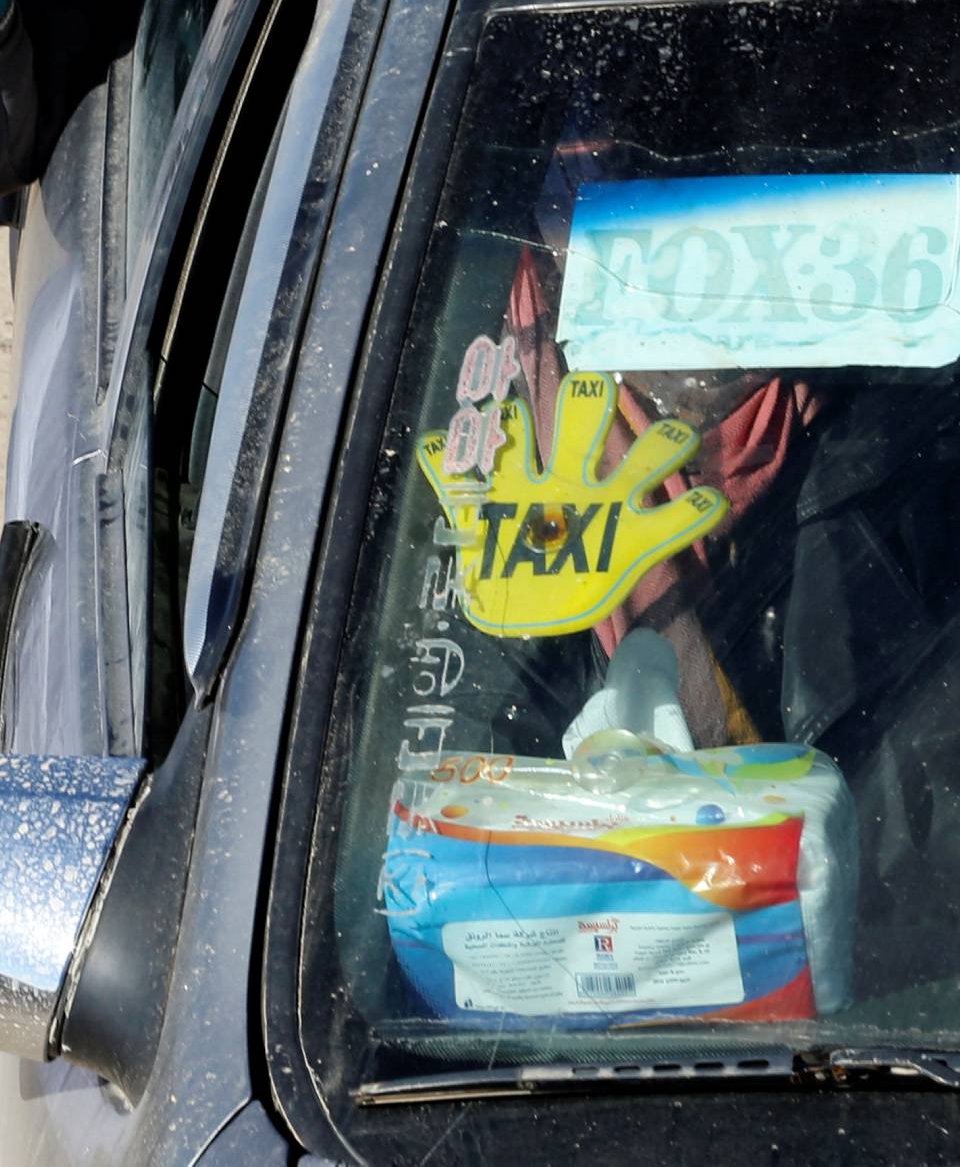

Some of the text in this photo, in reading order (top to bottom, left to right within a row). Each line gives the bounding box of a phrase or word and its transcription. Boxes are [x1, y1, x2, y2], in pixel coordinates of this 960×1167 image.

[573, 223, 950, 327] FOX36
[571, 380, 604, 398] TAXI
[658, 423, 690, 444] TAXI
[424, 435, 448, 456] TAX
[688, 491, 714, 513] TAXI
[478, 501, 623, 580] TAXI
[431, 755, 513, 786] 500
